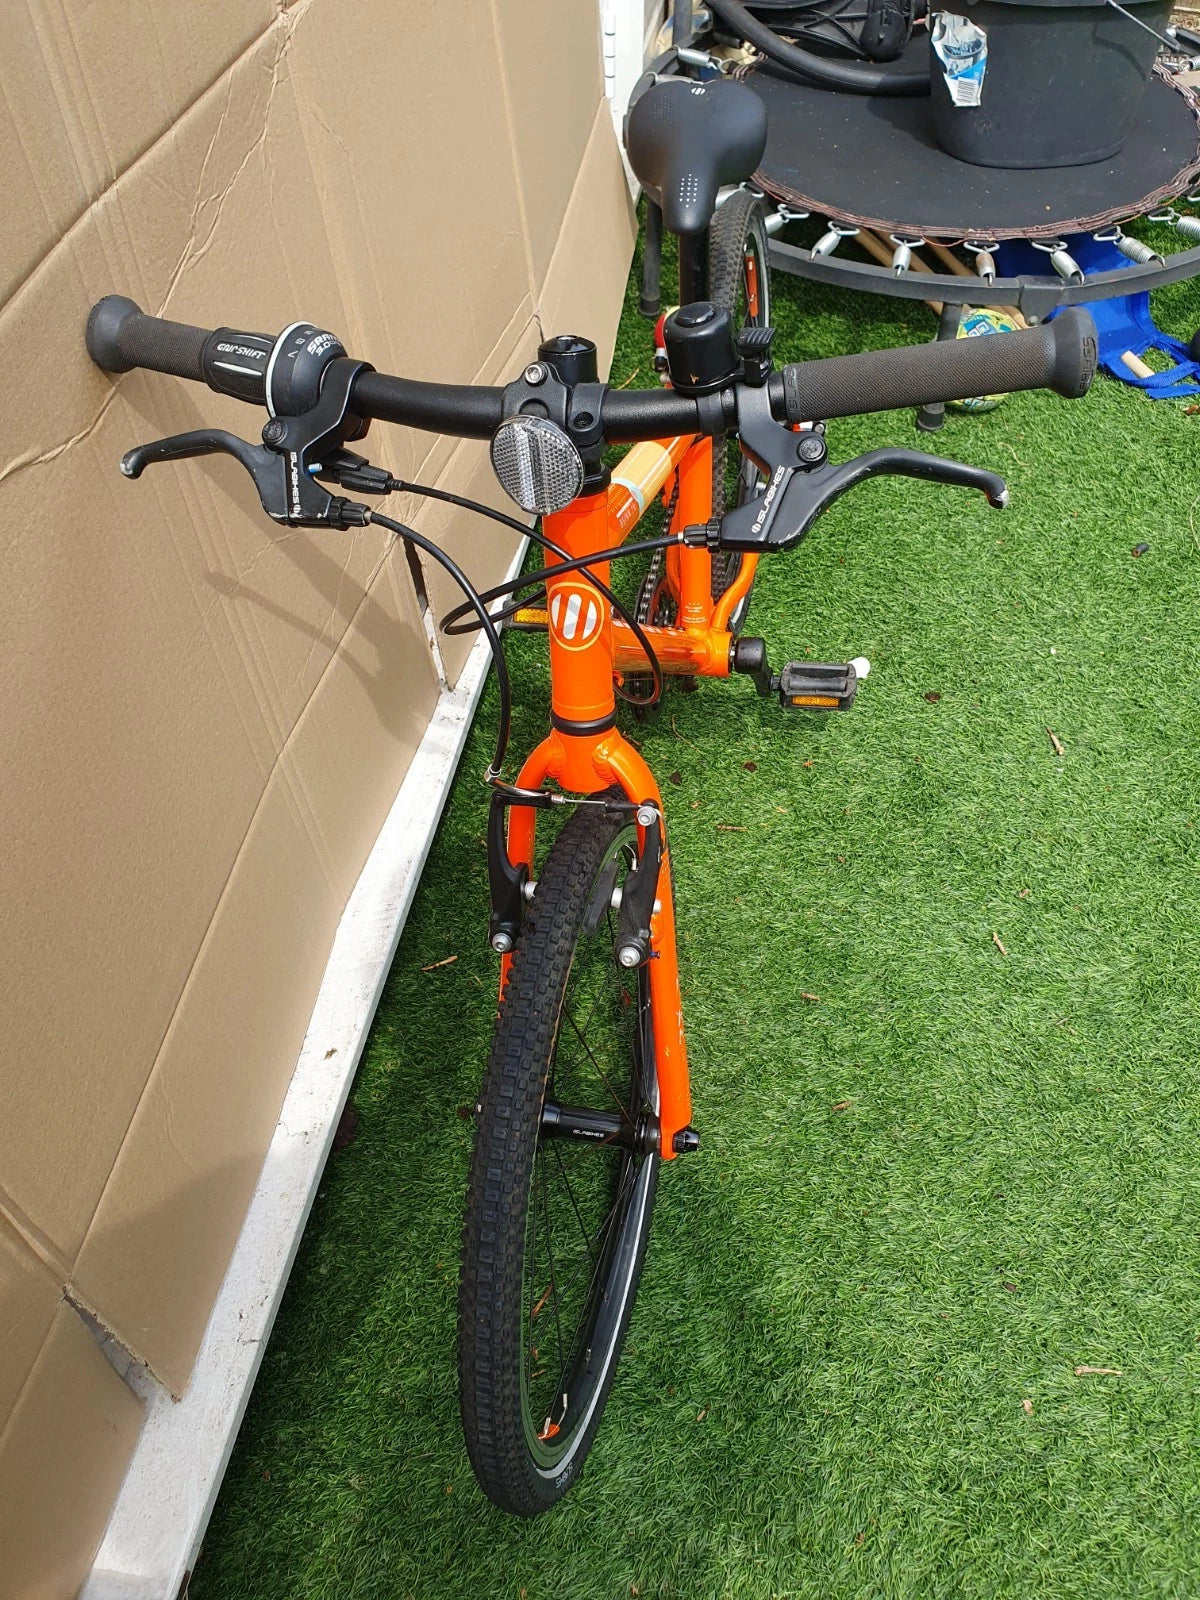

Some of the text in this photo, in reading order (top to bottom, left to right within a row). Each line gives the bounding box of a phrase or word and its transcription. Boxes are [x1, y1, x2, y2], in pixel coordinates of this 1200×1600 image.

[307, 333, 337, 355] SRAM
[290, 451, 300, 504] ISLABIKES
[756, 465, 786, 524] ISLABIKES
